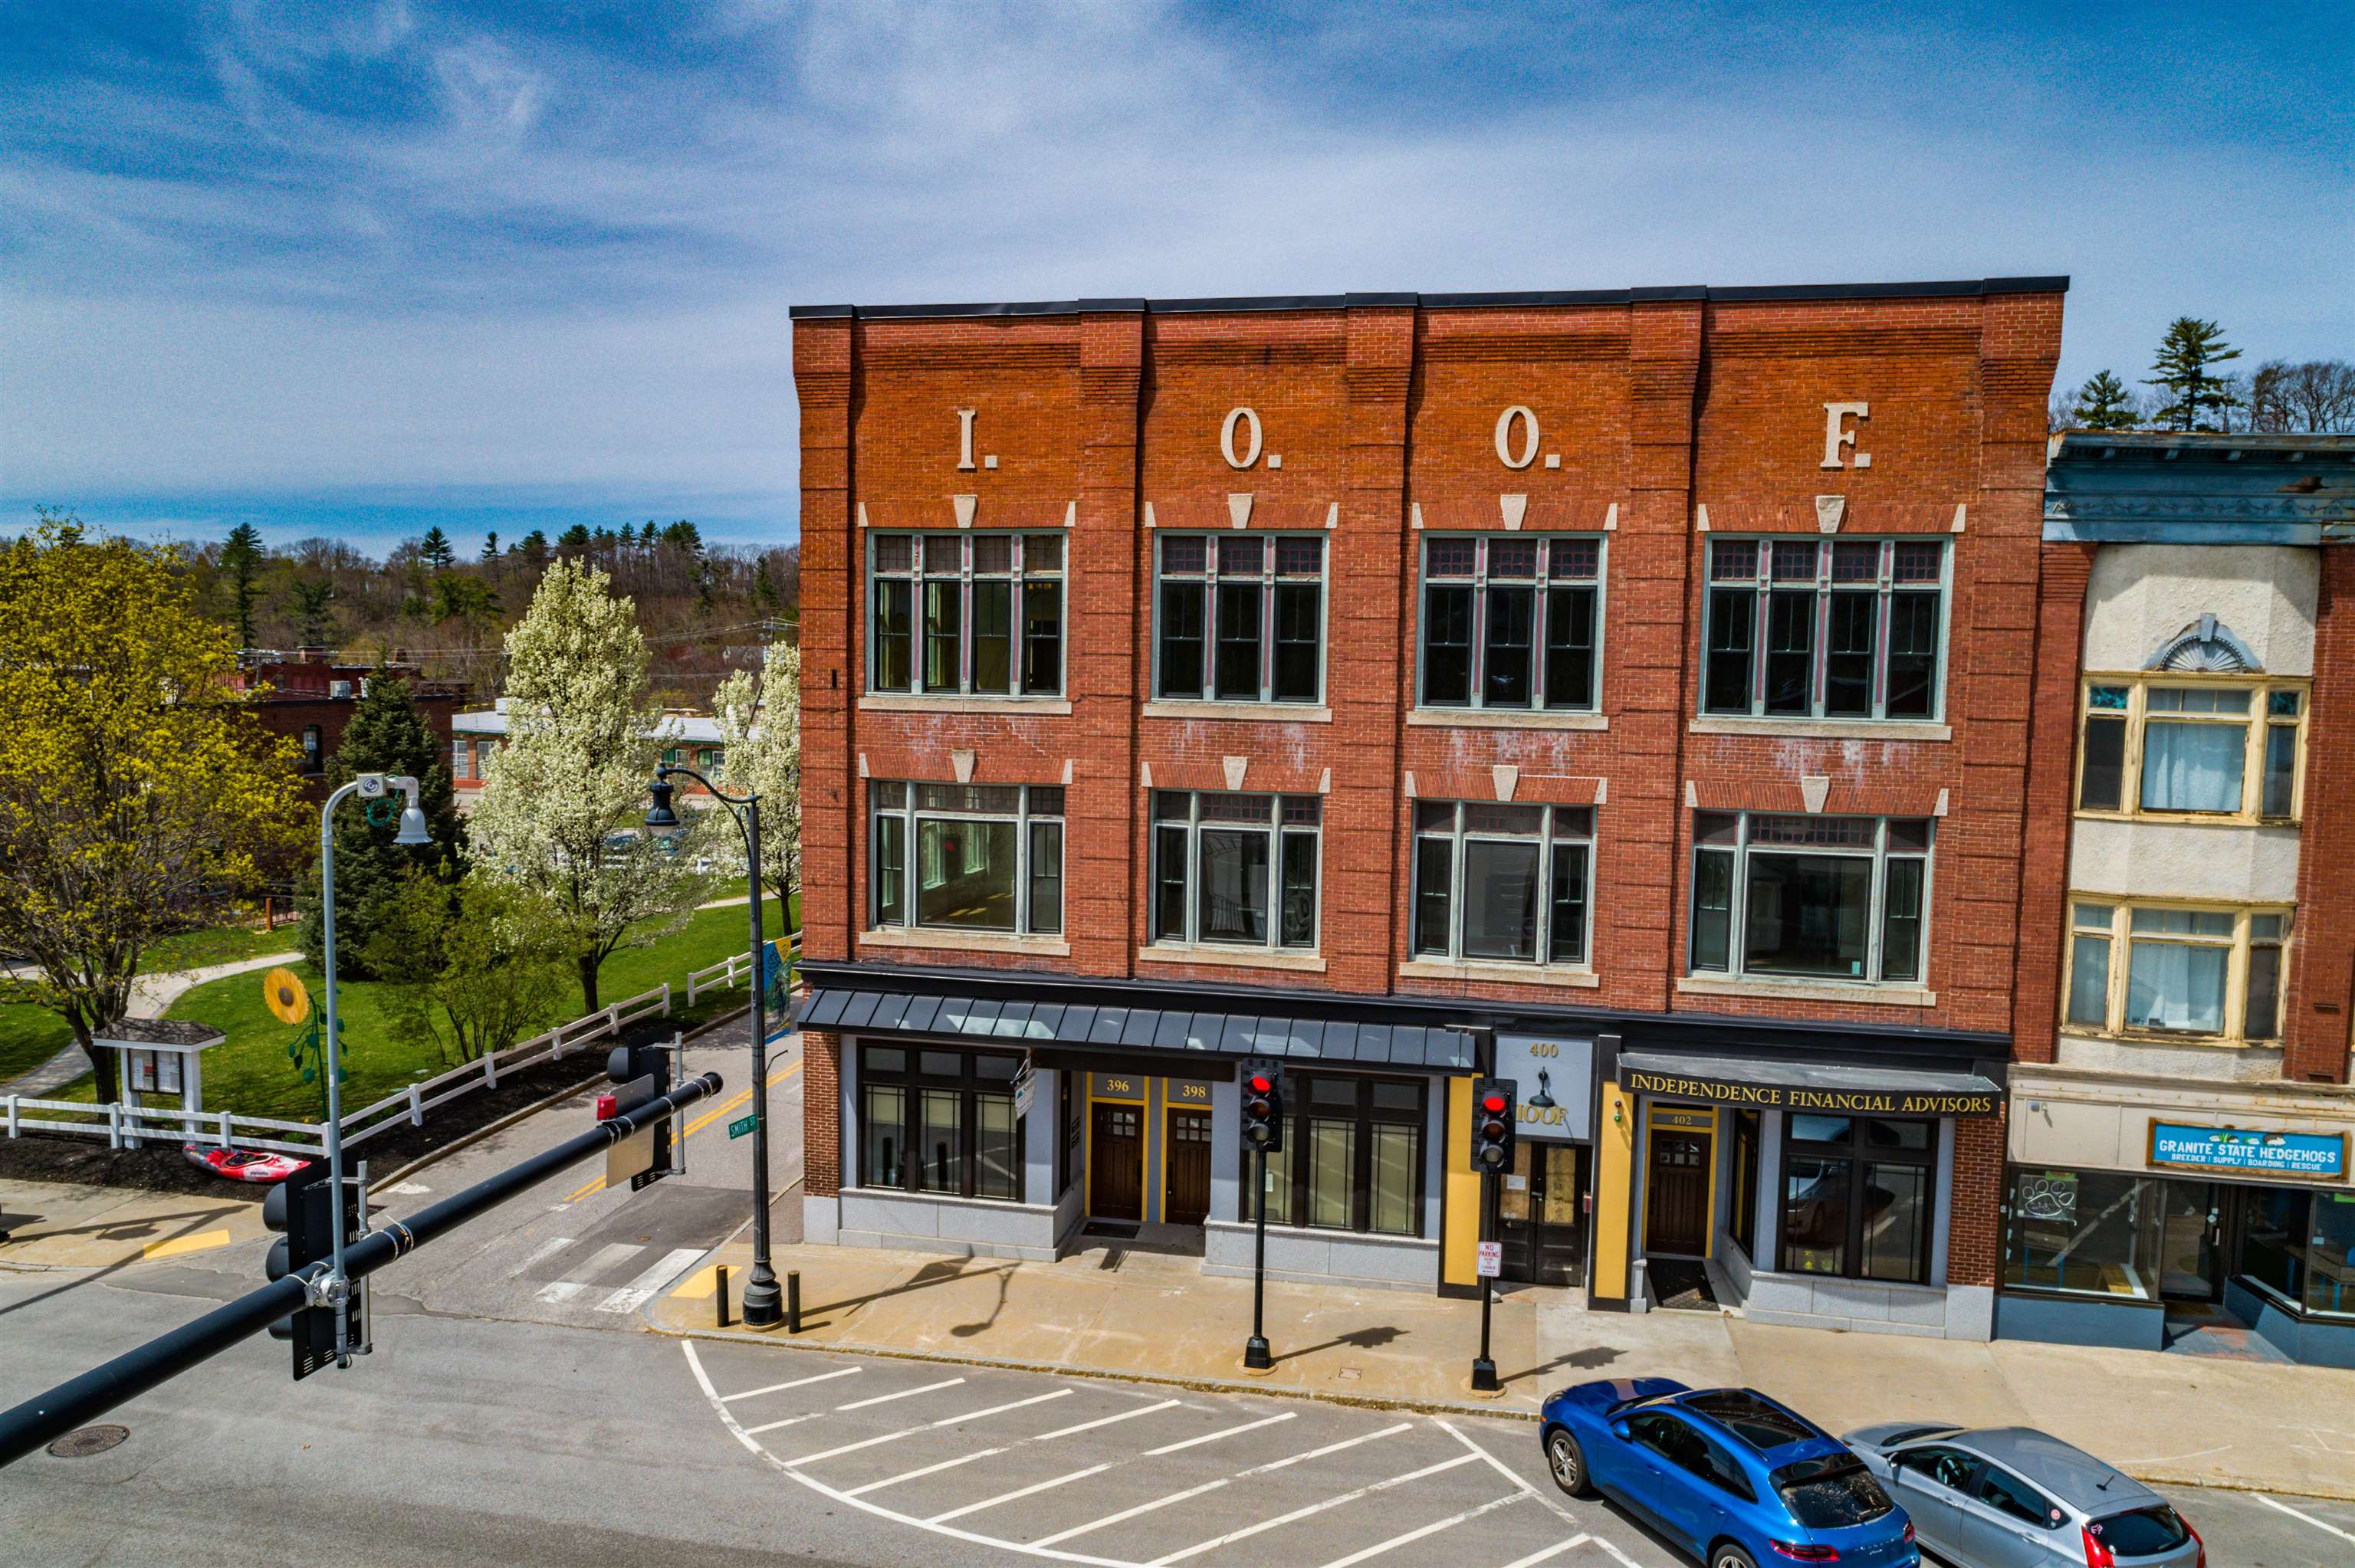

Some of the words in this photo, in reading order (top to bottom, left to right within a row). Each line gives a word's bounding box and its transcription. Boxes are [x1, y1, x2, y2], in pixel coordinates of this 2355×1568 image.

[1220, 406, 1282, 468] O.
[1495, 405, 1561, 468] O.
[1820, 402, 1871, 467] F.
[1529, 1042, 1559, 1058] 400
[1106, 1079, 1129, 1092] 396
[1182, 1084, 1207, 1098] 398
[1631, 1074, 1782, 1104] INDEPENDENCE
[1788, 1091, 1896, 1111] FINANCIAL
[1900, 1097, 1992, 1112] ADVISORS
[730, 1120, 748, 1137] SMITH
[750, 1116, 755, 1127] ST
[1671, 1114, 1693, 1125] 402
[2159, 1140, 2214, 1155] GRANITE
[2218, 1143, 2256, 1158] STATE
[2259, 1146, 2337, 1163] HEDGEHOGS
[2171, 1153, 2206, 1163] BREEDER
[2213, 1156, 2242, 1165] SUPPLY
[2247, 1158, 2285, 1169] BOARDING
[2291, 1161, 2322, 1171] RESCUE
